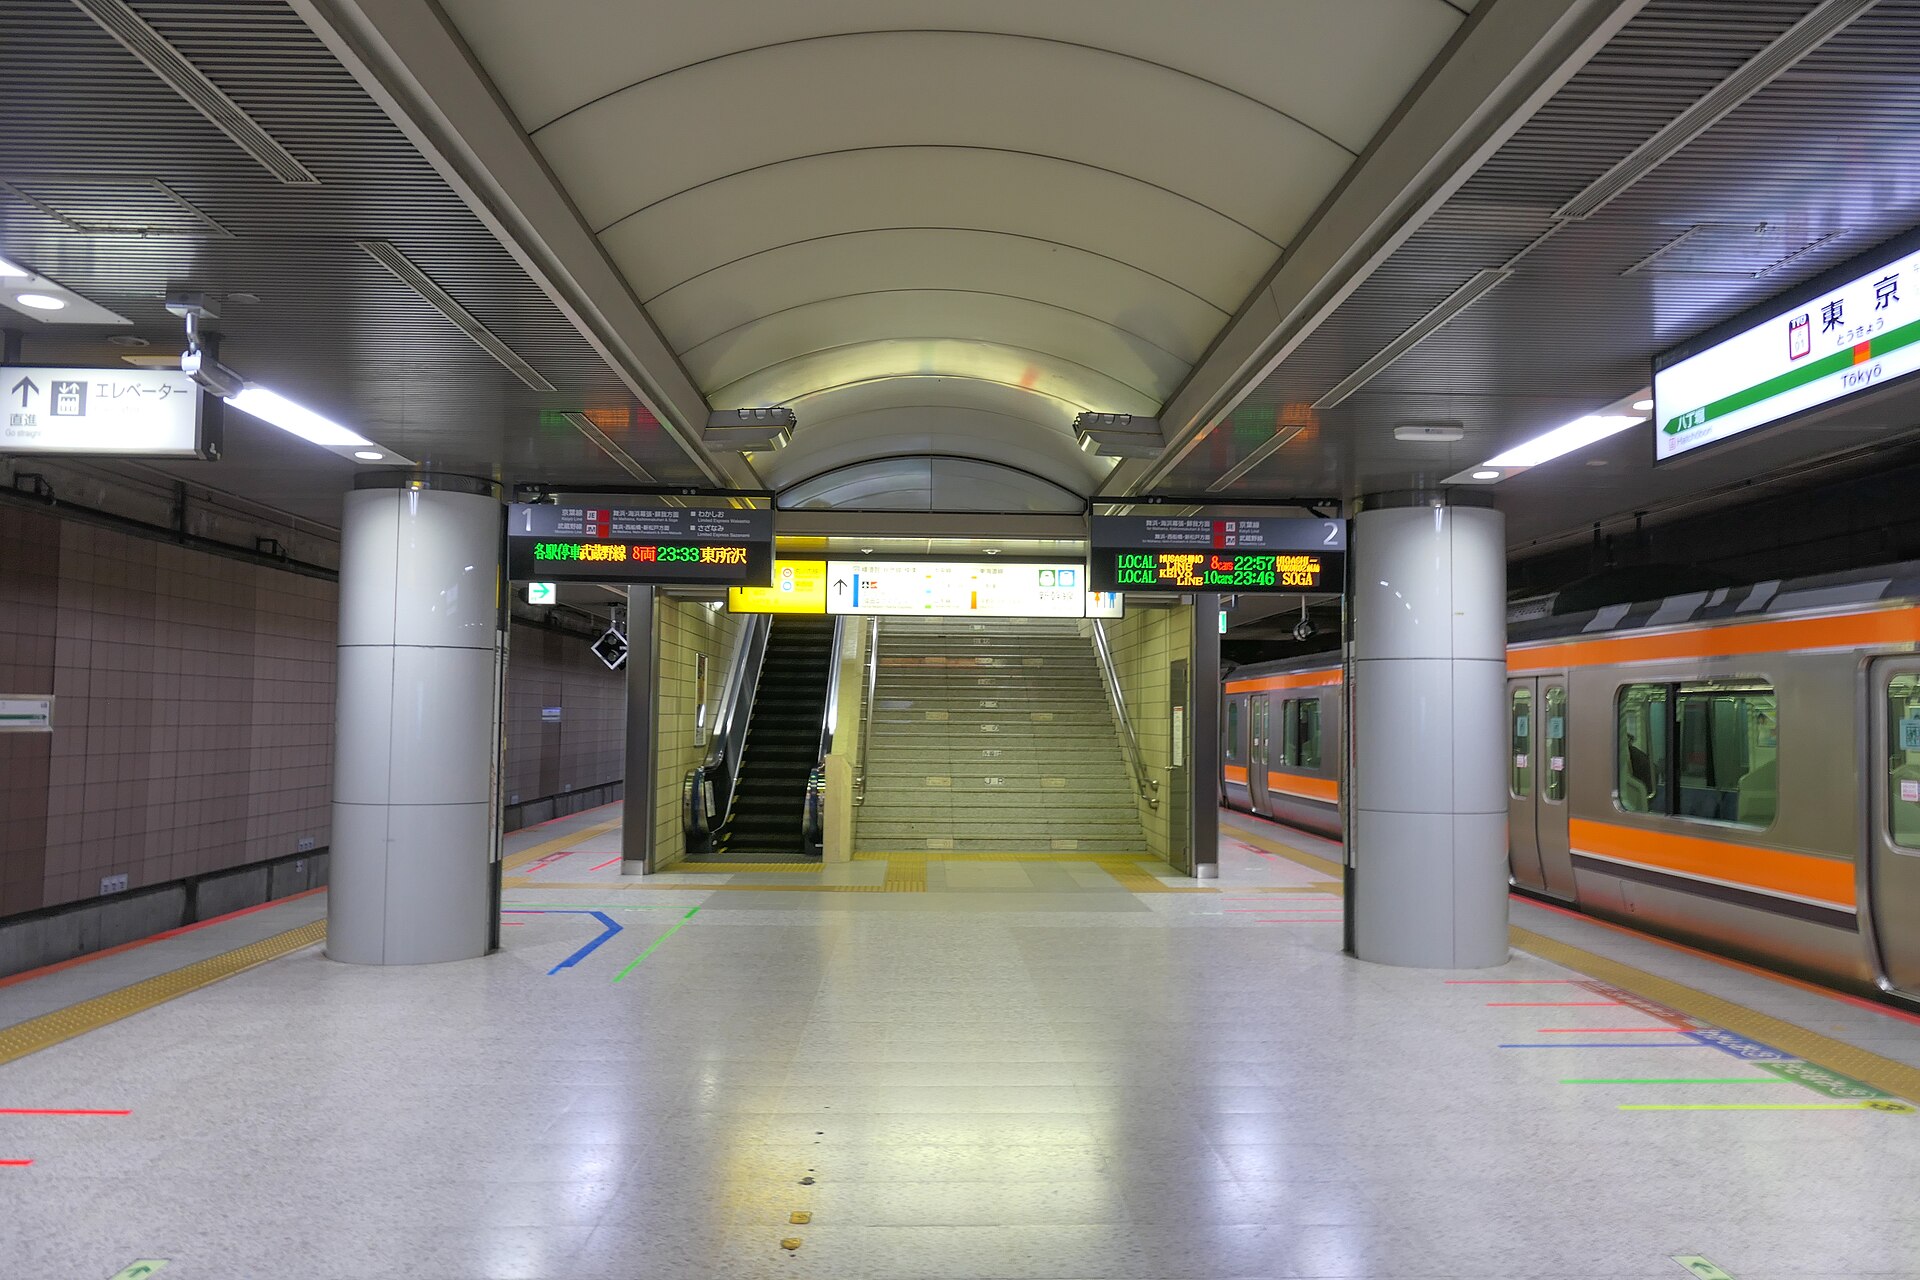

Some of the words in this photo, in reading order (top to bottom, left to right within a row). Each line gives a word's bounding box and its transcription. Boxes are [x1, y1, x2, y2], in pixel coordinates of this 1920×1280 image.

[1837, 318, 1884, 346] とうきょう
[95, 383, 188, 400] エレベーター
[10, 413, 38, 427] 直進
[522, 508, 532, 531] 1
[1323, 522, 1339, 546] 2
[579, 543, 627, 562] 武蔵野線
[632, 546, 656, 563] 8両
[657, 546, 699, 562] 23:33
[699, 547, 747, 564] 東所沢
[1118, 554, 1157, 569] LOCAL
[1159, 554, 1204, 564] MUSASHINO
[1234, 555, 1276, 571] 22:57
[1166, 562, 1194, 571] LINE
[1117, 569, 1157, 584] LOCAL
[1176, 576, 1204, 586] LINE
[1233, 571, 1275, 586] 23:46
[1282, 572, 1313, 586] SOGA
